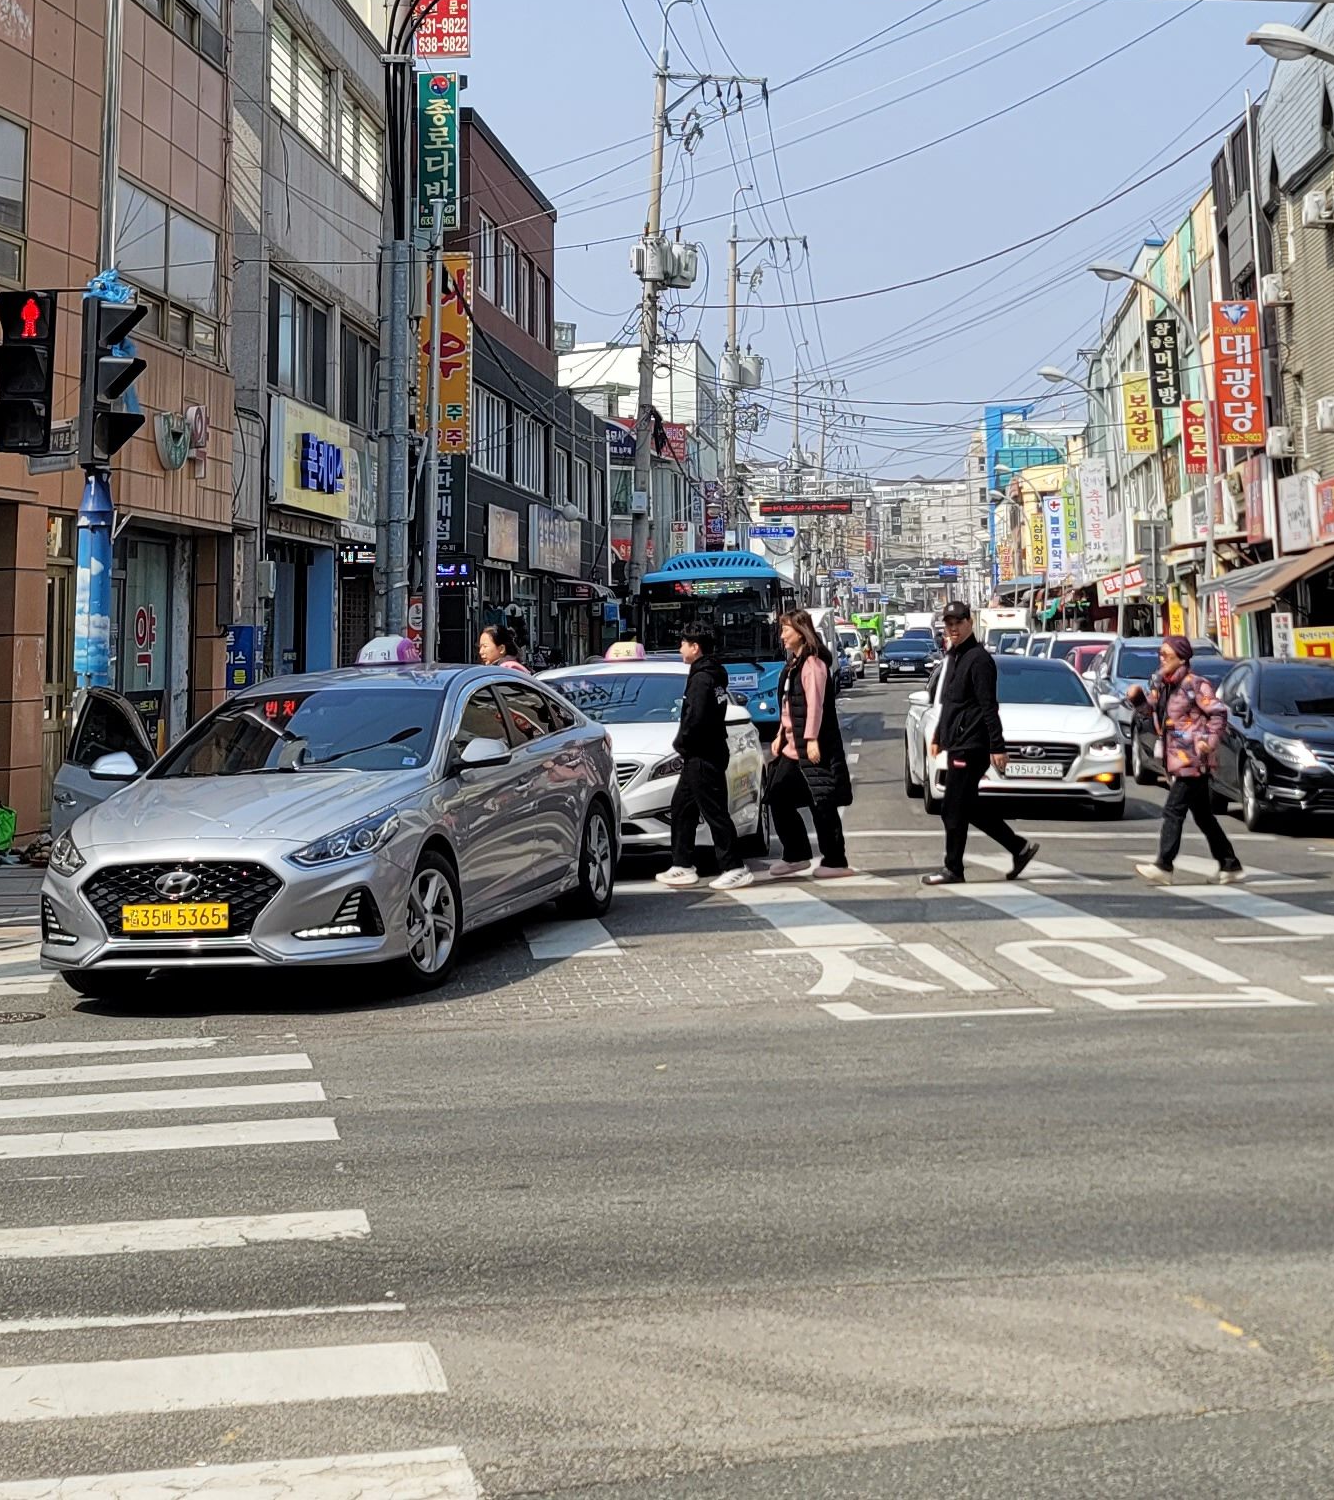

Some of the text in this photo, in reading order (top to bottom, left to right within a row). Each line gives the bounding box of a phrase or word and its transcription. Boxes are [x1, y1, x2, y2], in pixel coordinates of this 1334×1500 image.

[418, 35, 468, 53] 638-9822
[1153, 350, 1178, 405] 머리방
[1219, 333, 1259, 433] 대광당
[1128, 393, 1152, 443] 보성당
[134, 603, 158, 686] 약
[177, 907, 221, 926] 5365
